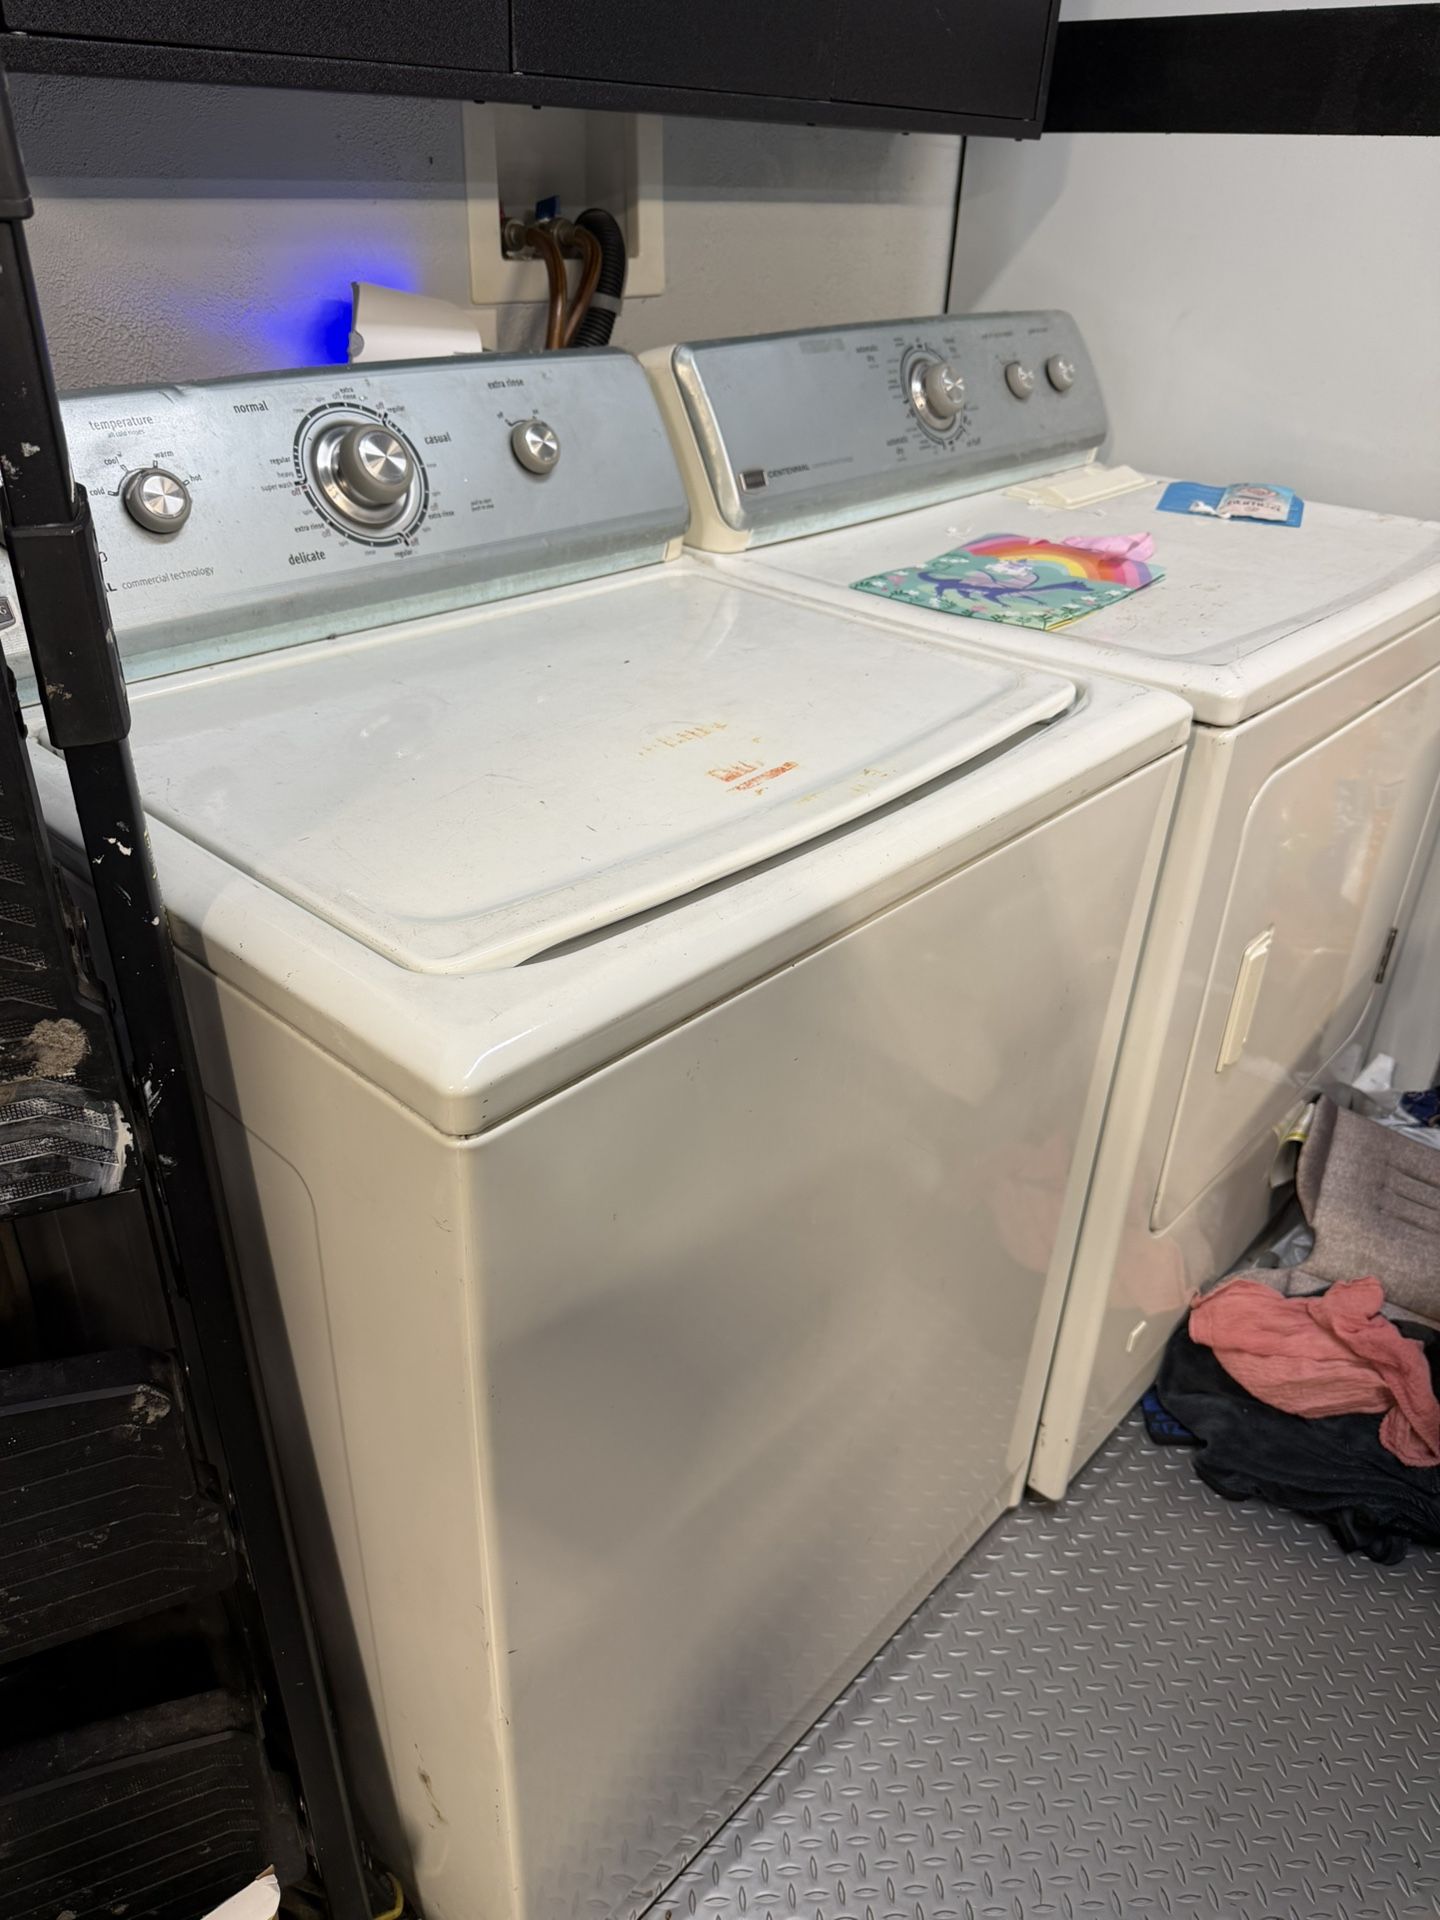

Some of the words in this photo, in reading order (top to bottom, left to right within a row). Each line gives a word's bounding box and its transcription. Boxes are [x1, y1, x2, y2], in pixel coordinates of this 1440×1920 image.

[487, 380, 506, 390] extra
[233, 400, 270, 415] normal
[88, 415, 155, 432] temperature
[423, 432, 452, 445] casual
[153, 450, 175, 459] warm
[104, 456, 120, 466] cool
[269, 456, 291, 466] regular
[189, 474, 203, 483] hot
[89, 487, 106, 497] cold
[294, 524, 310, 533] extra
[288, 550, 327, 566] delicate
[122, 572, 171, 590] commercial
[171, 566, 215, 582] technology
